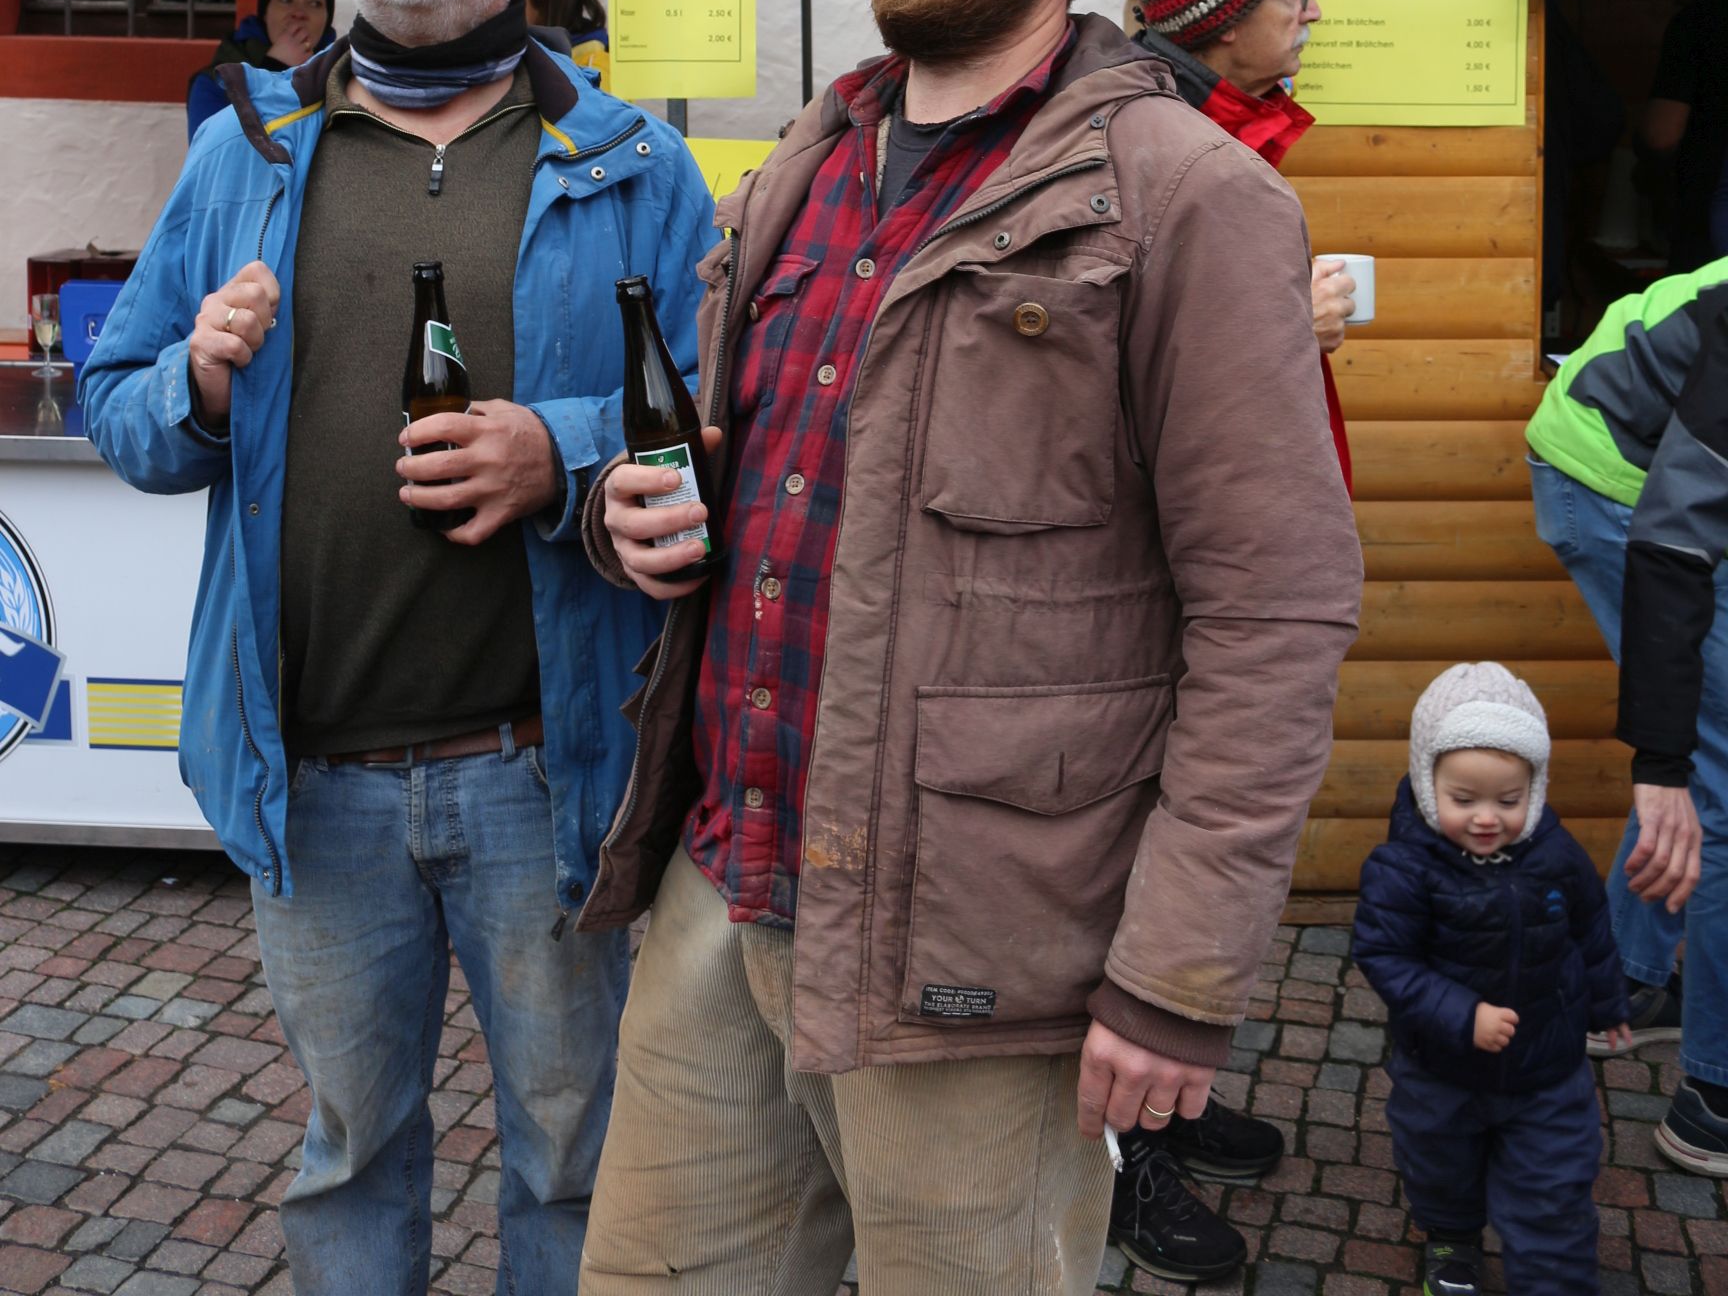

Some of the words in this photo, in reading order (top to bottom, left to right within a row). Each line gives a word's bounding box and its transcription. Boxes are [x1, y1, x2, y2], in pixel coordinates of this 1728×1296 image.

[1347, 17, 1386, 26] Brötchen
[1339, 40, 1353, 48] mit
[1356, 39, 1395, 48] Brötchen
